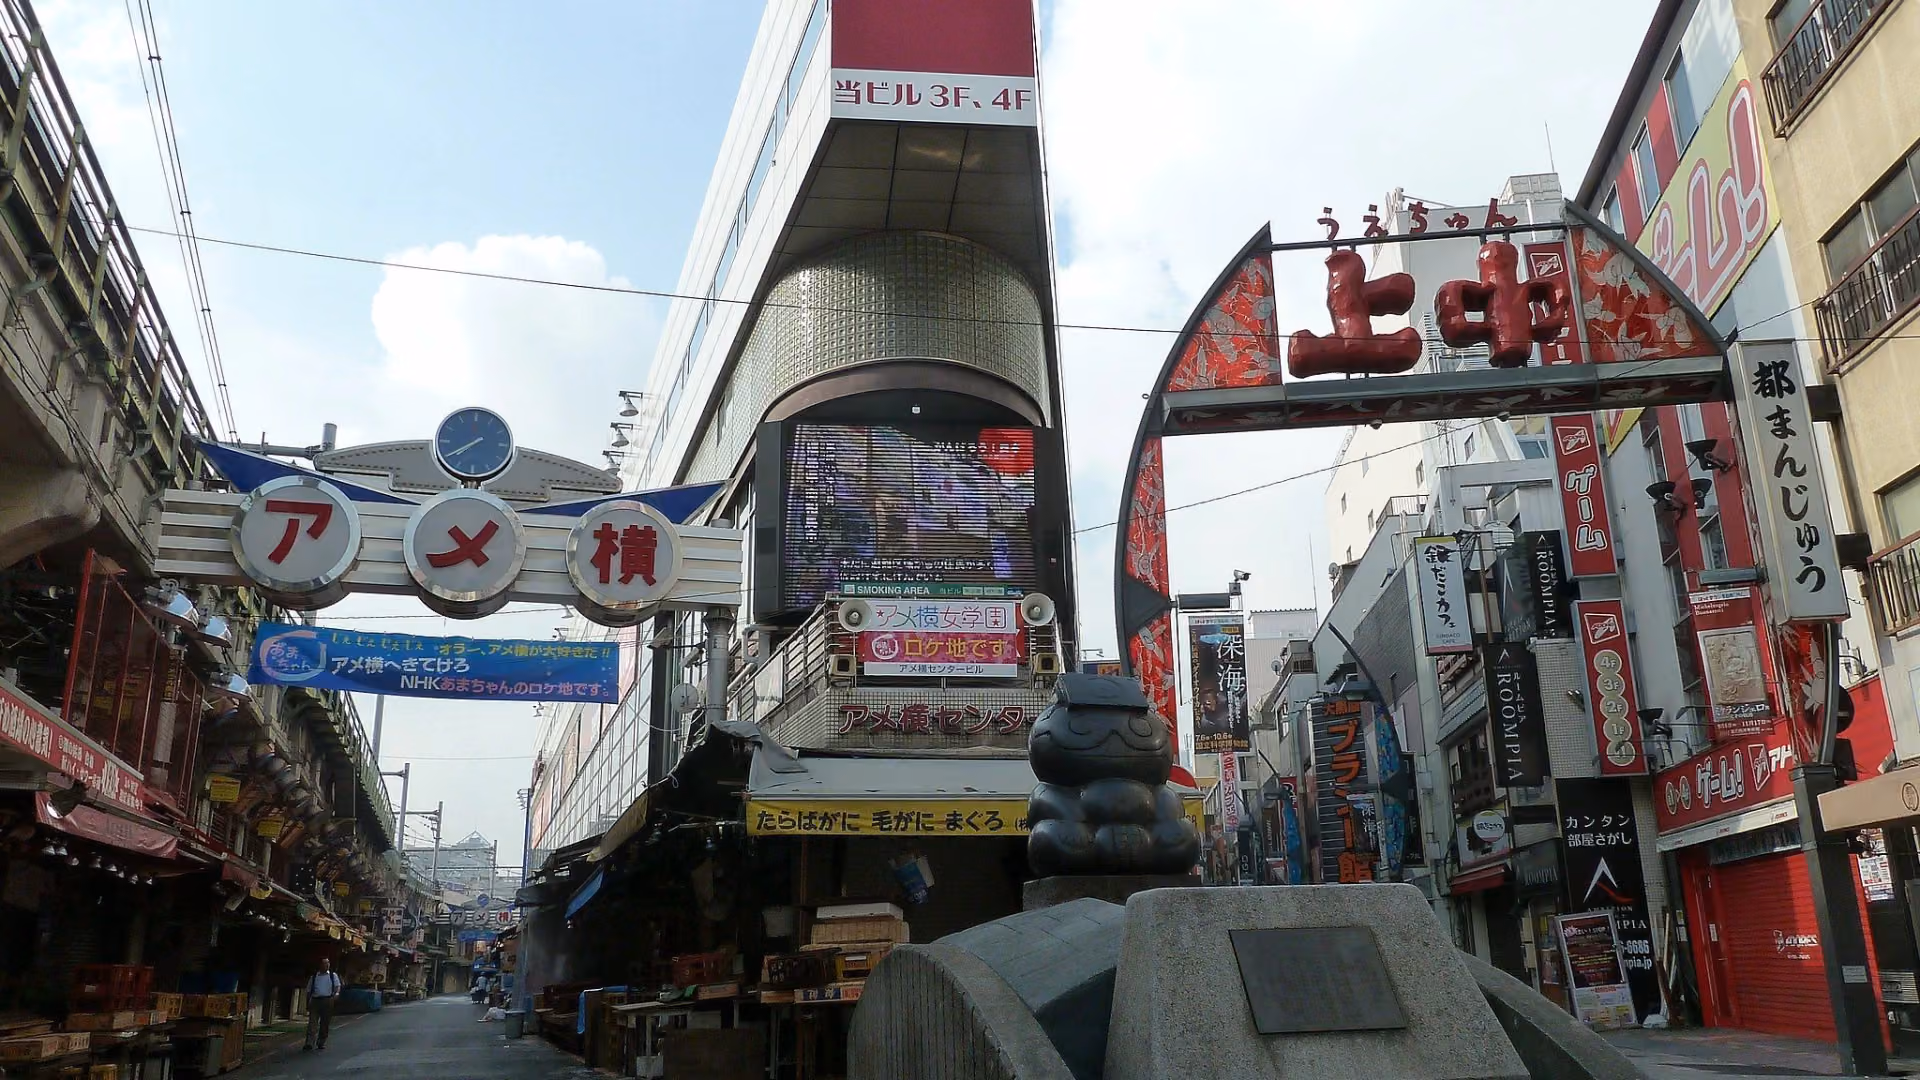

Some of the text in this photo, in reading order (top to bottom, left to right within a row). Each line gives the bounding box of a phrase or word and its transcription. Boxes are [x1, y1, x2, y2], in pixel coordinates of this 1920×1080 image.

[1316, 198, 1518, 241] うえちゅん
[1287, 240, 1567, 379] 上中
[1751, 359, 1828, 594] 都まんじゅう
[1564, 463, 1608, 552] ゲーム
[264, 499, 659, 586] アメ横
[857, 585, 930, 595] SMOKING AREA
[1535, 550, 1556, 626] ROOMPIA
[875, 603, 1007, 629] アメ横女学園
[904, 636, 1007, 658] ロケ地です
[331, 656, 471, 675] アメ横へきてけろ
[899, 663, 984, 674] アメ横センタービル
[1216, 634, 1247, 692] 深海
[1600, 656, 1617, 669] 4F
[400, 675, 609, 697] NHKあまちゃんのロケ地です。
[1603, 678, 1620, 690] 3F
[1605, 700, 1623, 713] 2F
[838, 703, 1036, 735] アメ横センタ
[1496, 673, 1525, 780] ROOMPIA
[1611, 723, 1625, 735] 1F
[1695, 748, 1745, 809] ゲーム!
[756, 810, 860, 831] たらばがに
[871, 810, 935, 832] 毛がに
[945, 810, 1004, 832] まぐろ
[1565, 814, 1631, 830] カンタン
[1567, 832, 1633, 848] 部屋さがし
[451, 911, 512, 923] アメ横
